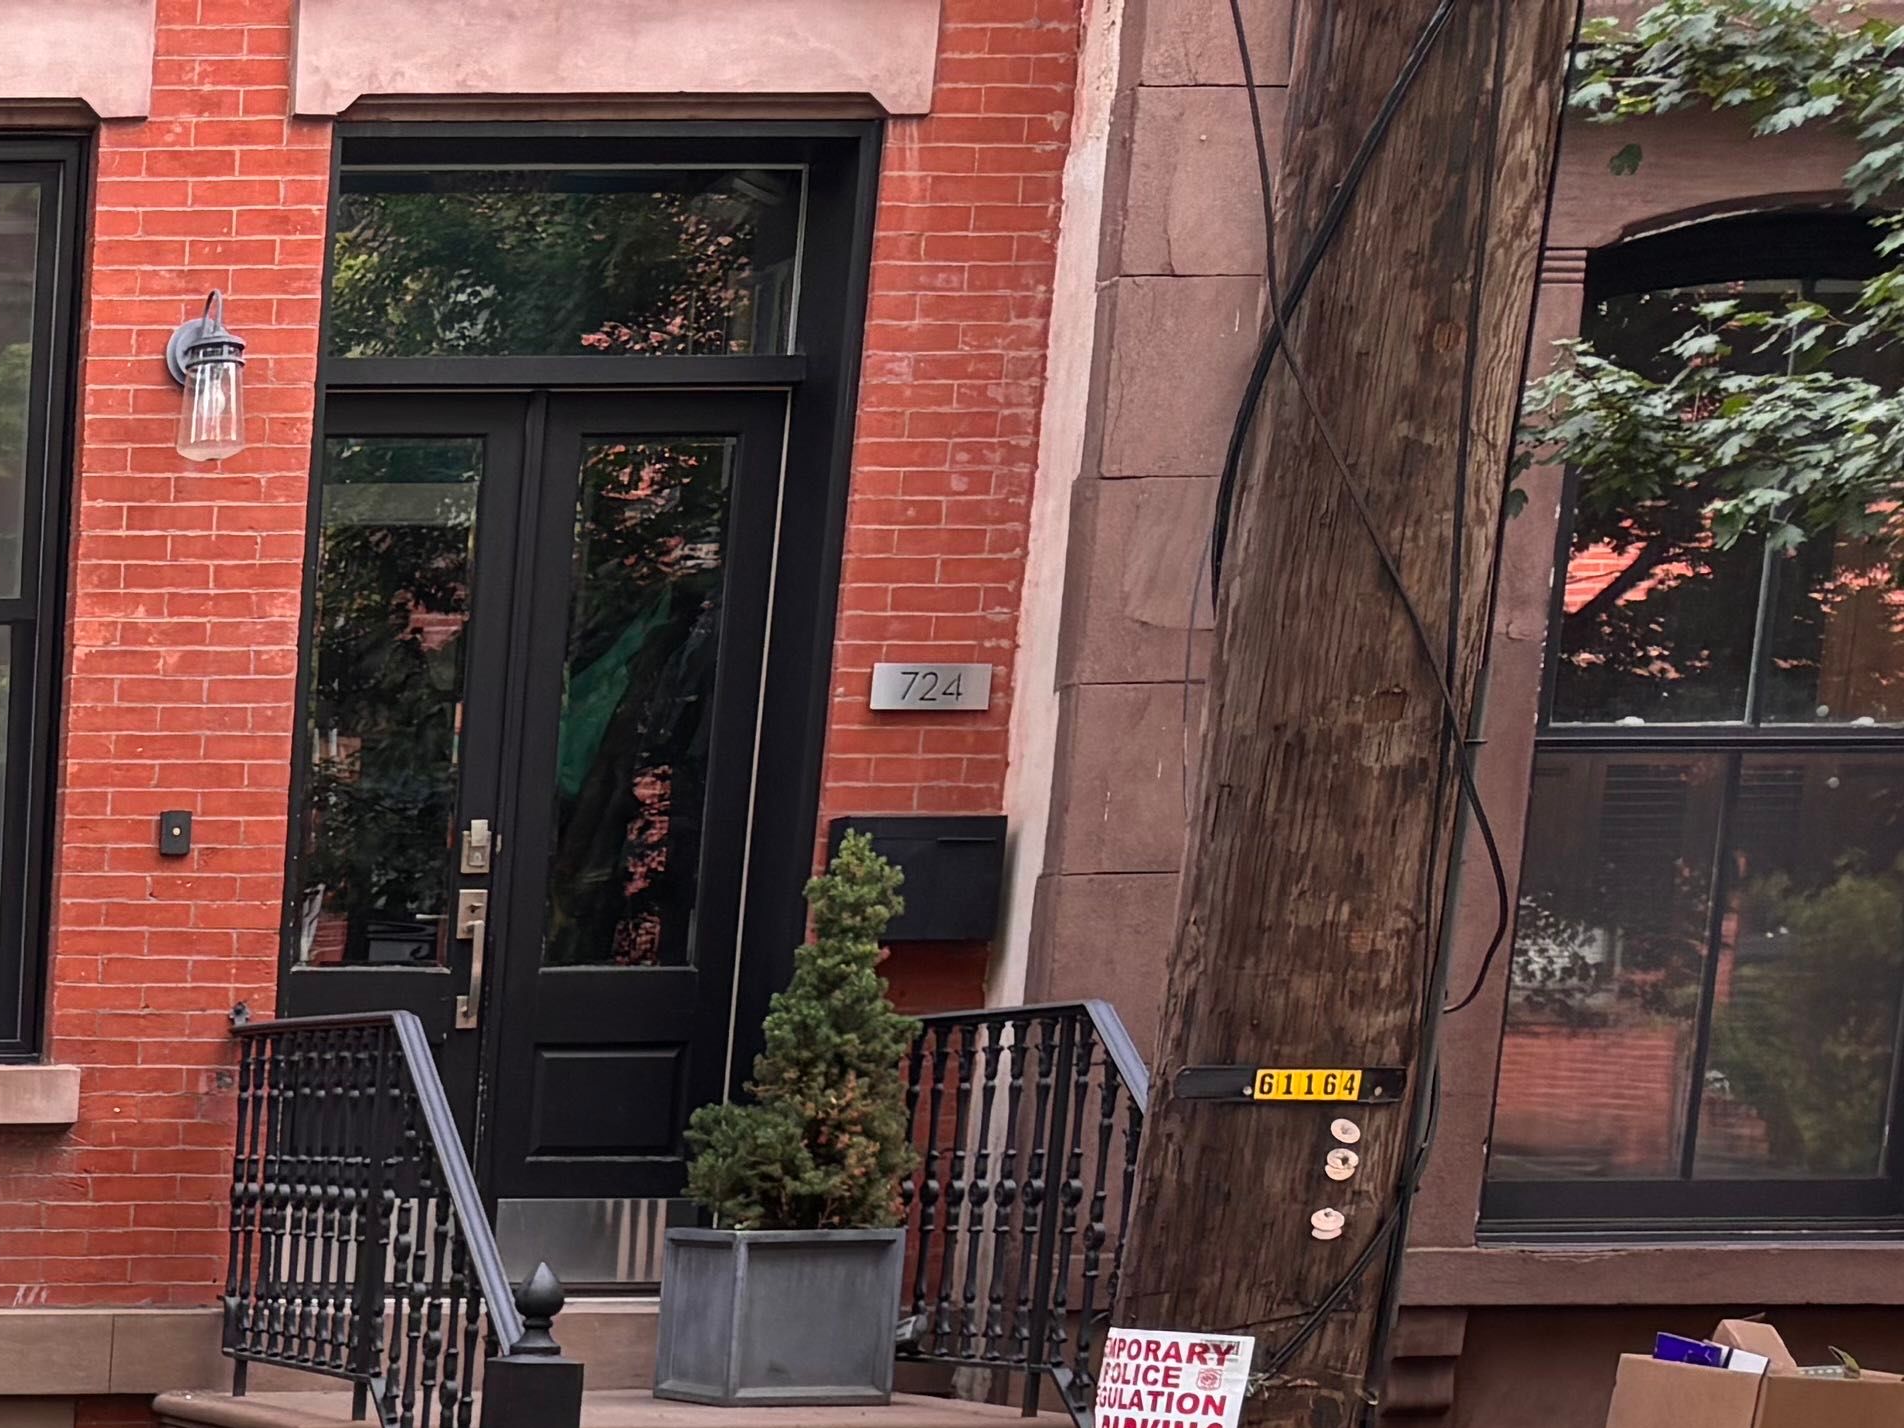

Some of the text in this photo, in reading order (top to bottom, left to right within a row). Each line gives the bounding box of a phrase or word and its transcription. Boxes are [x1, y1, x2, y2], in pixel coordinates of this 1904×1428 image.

[900, 671, 963, 701] 724
[1258, 1073, 1356, 1096] 61164
[1102, 1362, 1183, 1389] POLICE
